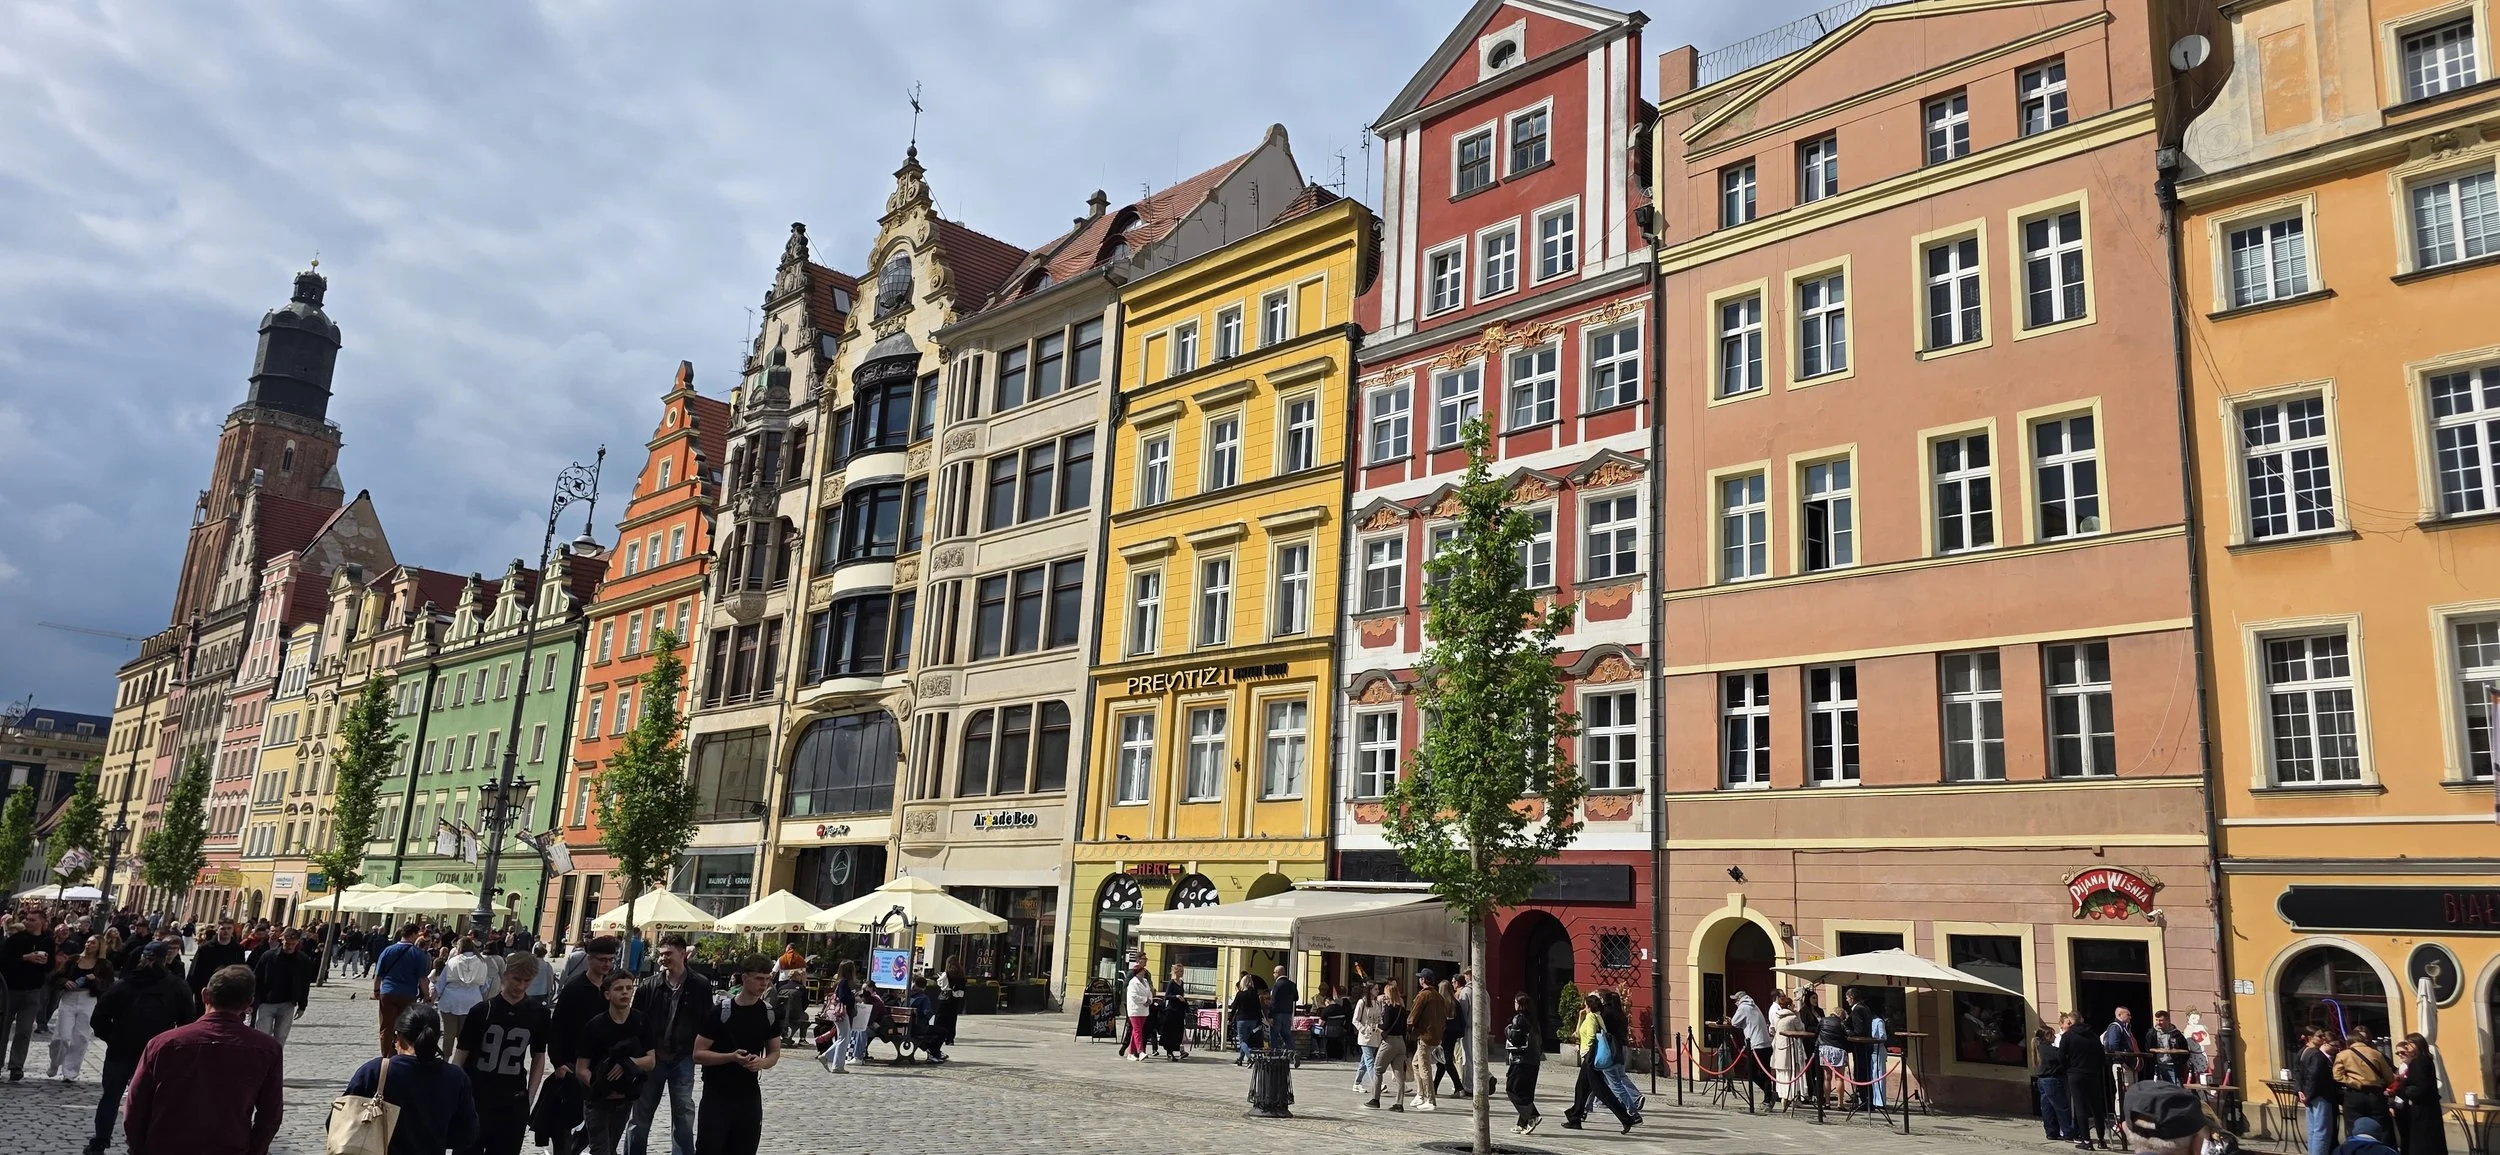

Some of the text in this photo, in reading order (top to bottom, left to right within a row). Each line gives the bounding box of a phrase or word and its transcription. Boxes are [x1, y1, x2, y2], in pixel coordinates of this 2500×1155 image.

[973, 811, 1035, 827] Arade Bee
[1137, 863, 1167, 875] HERT
[933, 925, 960, 934] ŻYWIEC
[476, 1024, 531, 1075] 92
